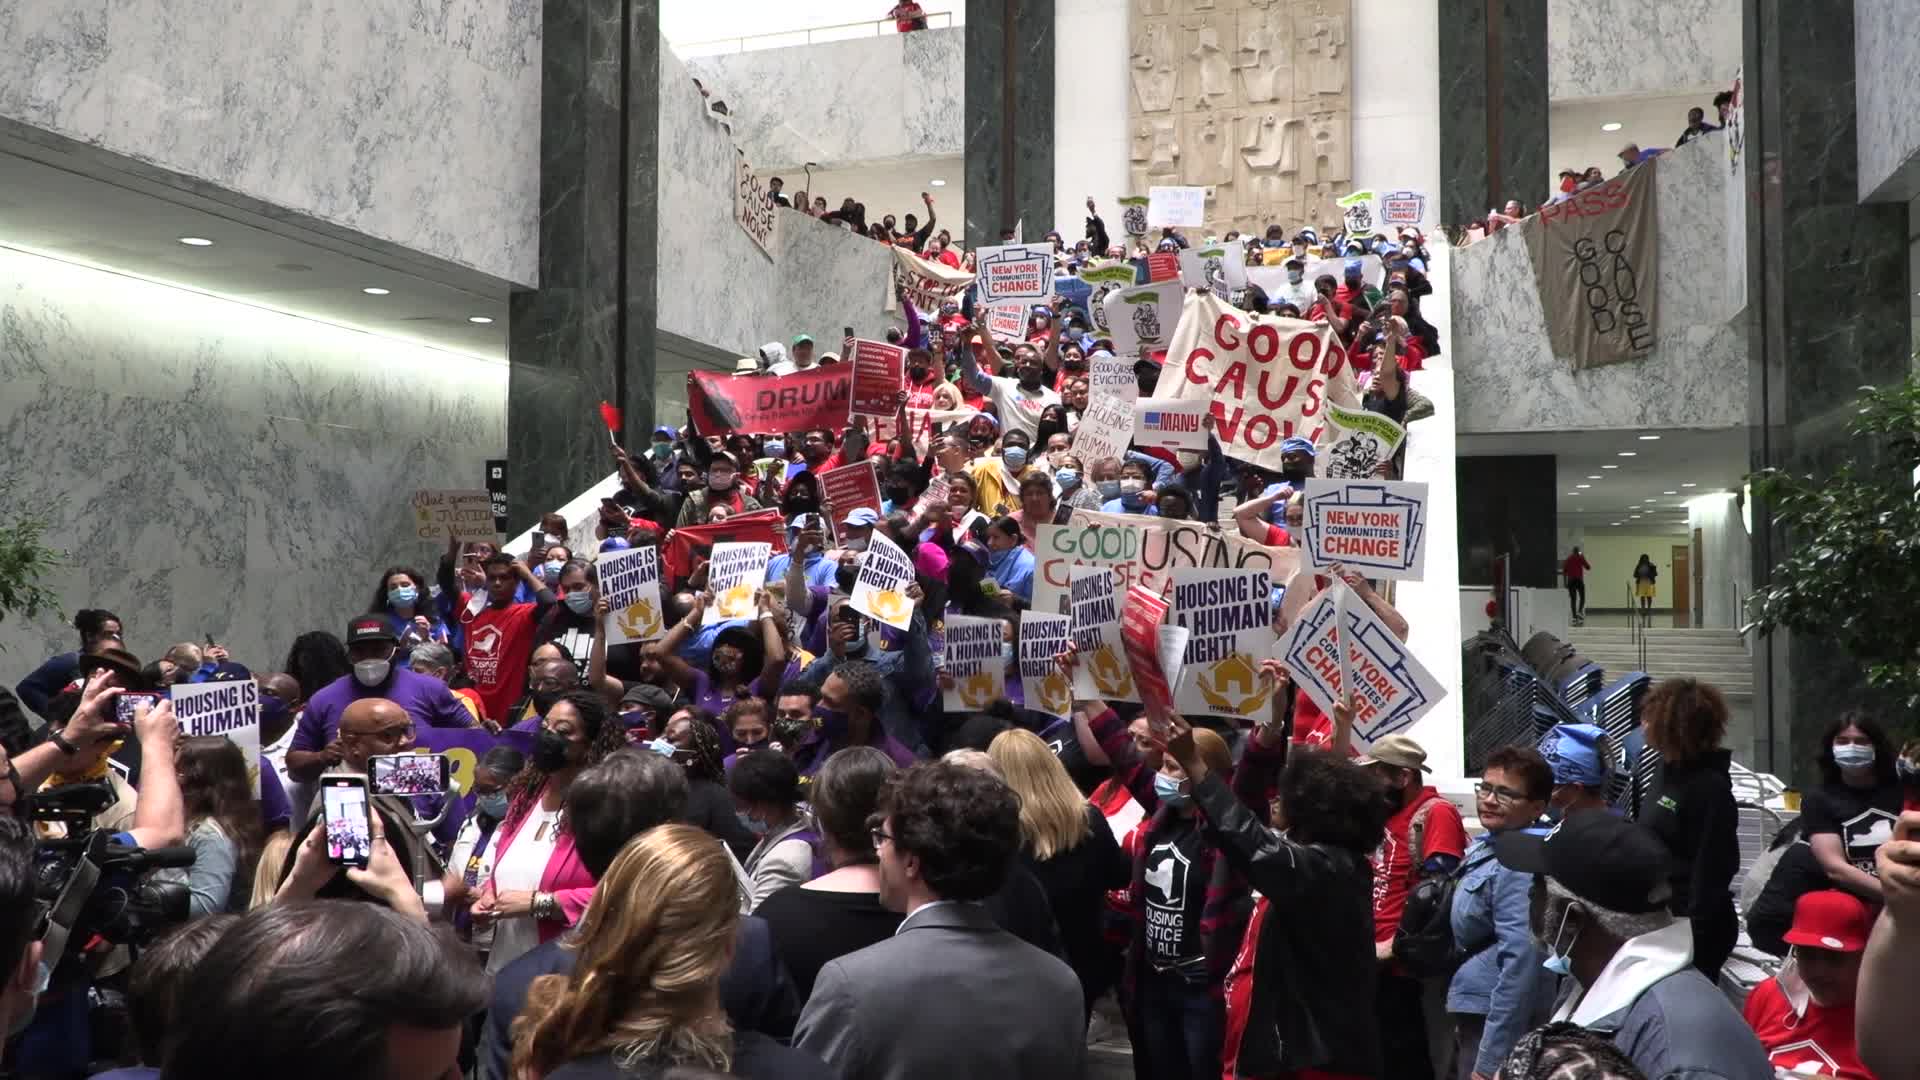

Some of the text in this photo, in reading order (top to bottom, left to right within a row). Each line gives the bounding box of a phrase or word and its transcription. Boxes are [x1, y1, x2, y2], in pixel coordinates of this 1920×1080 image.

[740, 180, 775, 231] CAUSE
[1539, 181, 1632, 224] PASS
[991, 264, 1038, 275] NEW YORK
[992, 280, 1038, 292] CHANGE
[1574, 238, 1616, 334] GOOD
[1604, 230, 1653, 351] CAUSE
[992, 317, 1019, 331] CHANGE
[1214, 314, 1346, 380] GOOD
[1093, 375, 1135, 386] EVICTION
[756, 378, 849, 411] DRUM
[1086, 402, 1133, 432] HOUSING
[1160, 412, 1200, 432] MANY
[1336, 412, 1359, 423] MAKE
[1361, 416, 1378, 424] THE
[1378, 421, 1399, 438] ROAD
[1078, 432, 1116, 457] HUMAN
[1326, 510, 1400, 528] NEW YORK
[1052, 528, 1137, 560] GOOD
[1326, 526, 1394, 538] COMMUNITIES
[712, 544, 768, 565] HOUSING IS
[870, 540, 908, 566] HOUSING
[1324, 536, 1400, 558] CHANGE
[600, 548, 655, 580] HOUSING IS
[710, 558, 766, 580] A HUMAN
[864, 554, 874, 568] A
[602, 564, 656, 596] A HUMAN
[860, 568, 898, 592] RIGHT!
[1072, 574, 1101, 604] HOUSING
[1104, 570, 1112, 596] IS
[1176, 576, 1248, 610] HOUSING
[1252, 572, 1269, 600] IS
[608, 588, 640, 612] IGHT!
[1072, 605, 1077, 629] A
[1080, 598, 1116, 626] HUMAN
[1177, 613, 1188, 628] A
[1194, 601, 1270, 636] HUMAN
[946, 623, 1001, 644] HOUSING IS
[1022, 620, 1066, 640] HOUSING
[946, 642, 1002, 662] A HUMAN
[1020, 640, 1067, 660] A HUMA
[1022, 659, 1056, 678] RIGHT!
[1359, 658, 1399, 702] YORK
[1306, 646, 1378, 724] CHAGE
[175, 682, 256, 719] HOUSING IS
[178, 704, 256, 736] A HUMAN
[1146, 906, 1183, 927] OUSING
[1158, 942, 1181, 956] ALL
